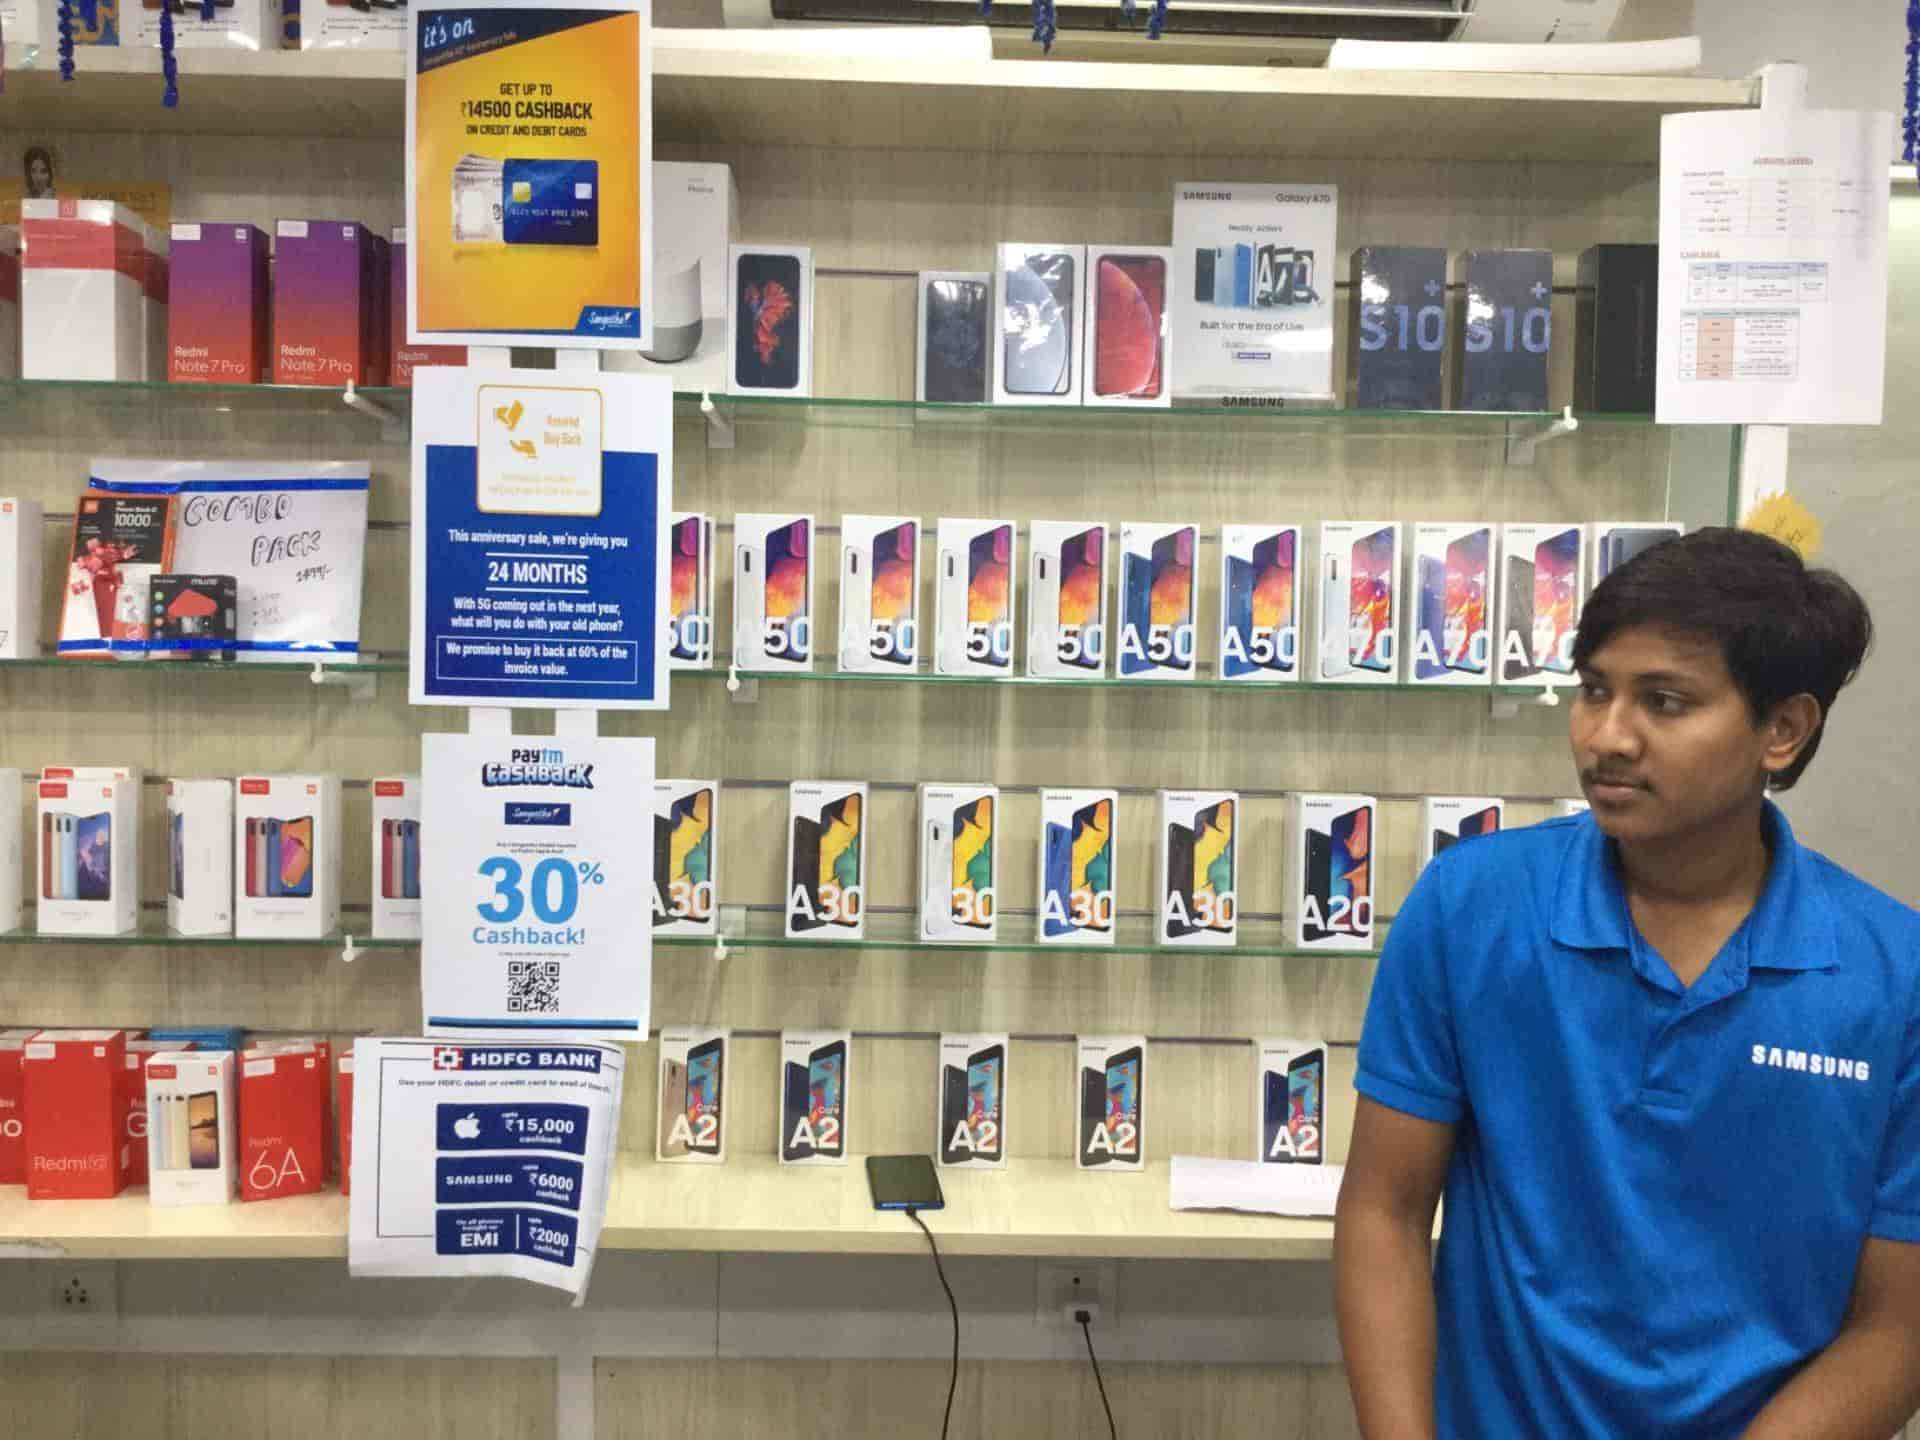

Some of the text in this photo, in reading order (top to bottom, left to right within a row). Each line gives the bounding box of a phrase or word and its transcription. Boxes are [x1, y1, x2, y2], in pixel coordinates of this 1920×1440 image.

[424, 16, 447, 48] it's
[452, 18, 474, 38] on
[500, 83, 552, 96] GET UP TO
[515, 102, 592, 119] CASHBACK
[1183, 191, 1232, 201] SAMSUNG
[175, 346, 208, 357] Redmi
[281, 345, 316, 356] Redmi
[175, 360, 246, 373] Note 7 Pro
[281, 359, 353, 373] Note 7 Pro
[114, 514, 151, 527] 10000
[448, 529, 628, 549] This anniversary sale, we're giving you
[488, 561, 588, 584] 24 MONTHS
[454, 597, 475, 610] With
[477, 598, 491, 610] 5G
[493, 599, 527, 613] coming
[529, 601, 545, 612] out
[547, 600, 556, 612] in
[558, 600, 573, 613] the
[450, 616, 624, 633] what will you do with your old phone?
[446, 642, 461, 655] We
[462, 644, 500, 657] promise
[502, 644, 512, 655] to
[514, 644, 531, 659] buy
[533, 644, 541, 656] it
[544, 644, 565, 657] back
[567, 646, 577, 657] at
[600, 646, 611, 658] of
[612, 646, 628, 659] the
[1120, 624, 1194, 662] A50
[1222, 626, 1298, 666] A50
[504, 661, 569, 675] invoice value.
[511, 748, 563, 763] paytm
[476, 856, 604, 925] 30%
[790, 884, 864, 922] A30
[1038, 888, 1113, 928] A30
[1164, 889, 1235, 929] A30
[1302, 894, 1373, 934] A20
[472, 926, 585, 945] Cashback!
[471, 1052, 596, 1069] HDFC BANK
[1751, 1044, 1871, 1081] SAMSUNG
[666, 1113, 718, 1146] A2
[789, 1116, 841, 1149] A2
[948, 1119, 999, 1153] A2
[1086, 1121, 1137, 1154] A2
[1270, 1124, 1320, 1157] A2
[34, 1155, 86, 1169] Redmi
[249, 1148, 305, 1190] 6A
[446, 1174, 513, 1185] SAMSUNG
[461, 1232, 499, 1247] EMI
